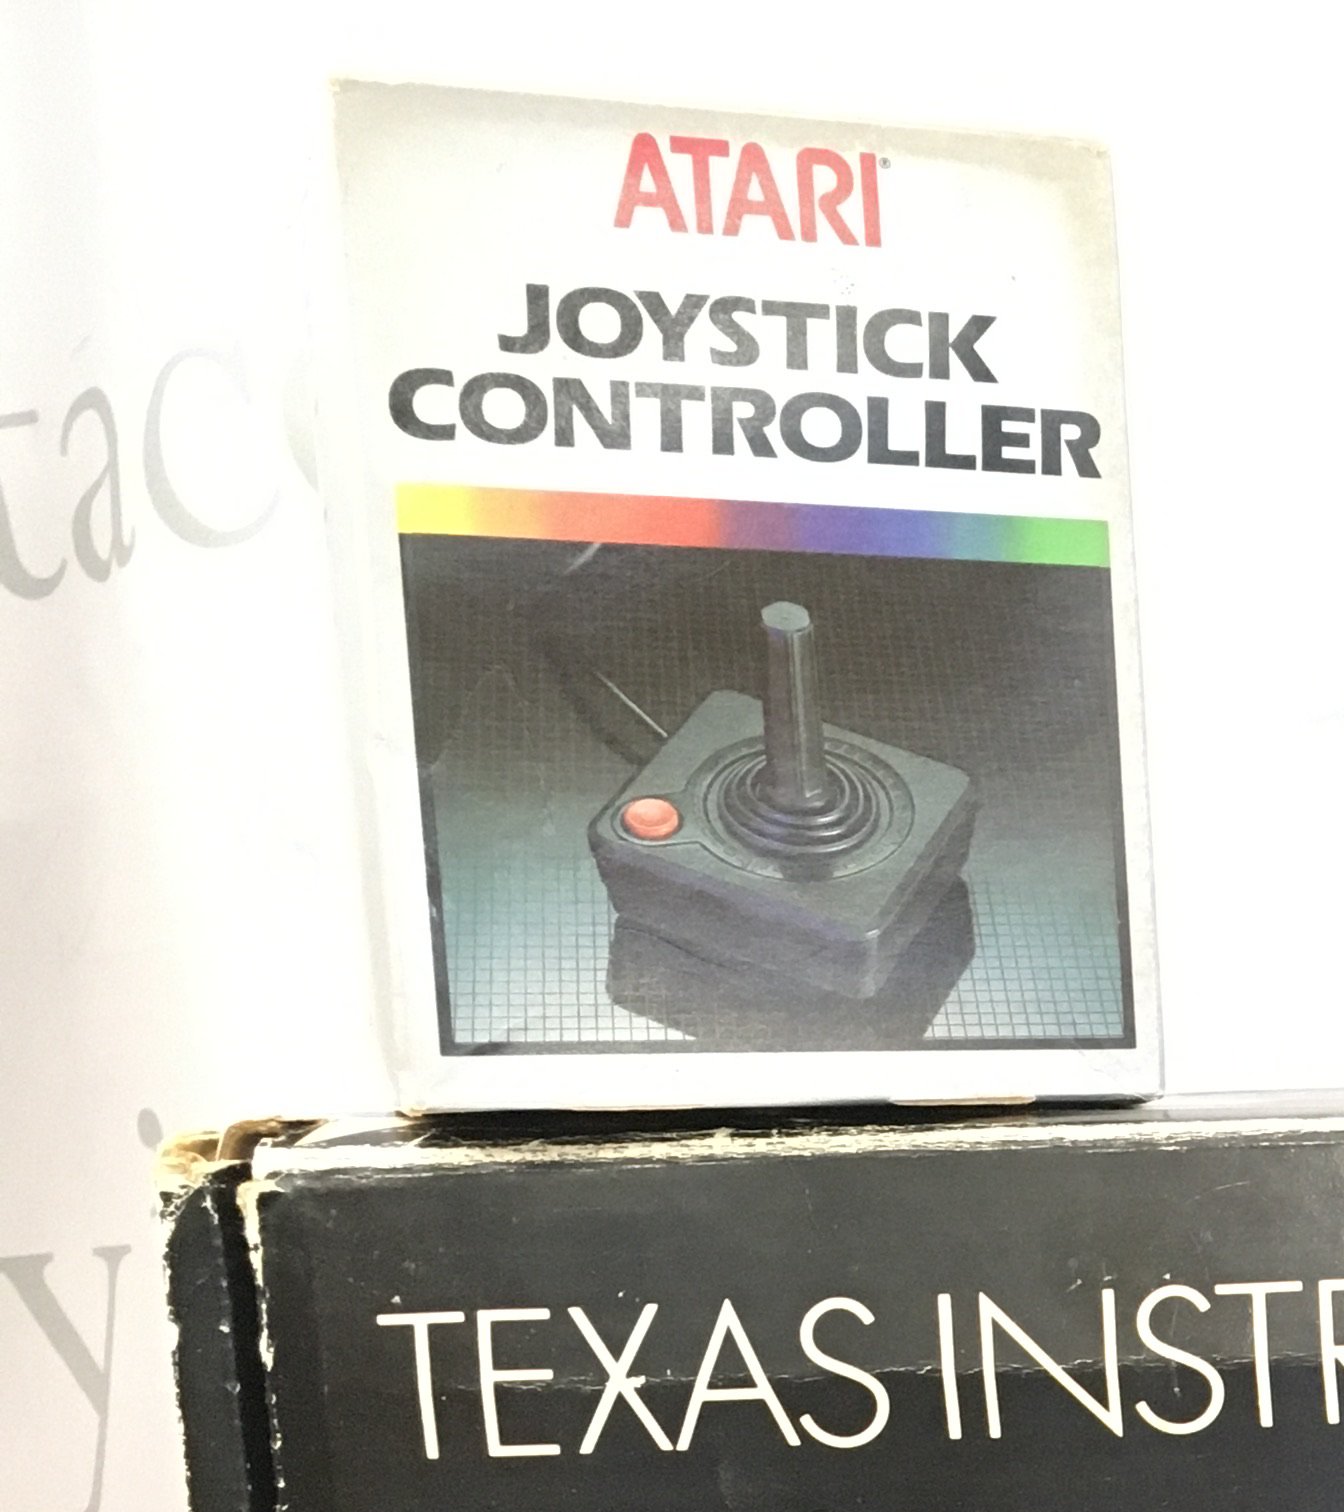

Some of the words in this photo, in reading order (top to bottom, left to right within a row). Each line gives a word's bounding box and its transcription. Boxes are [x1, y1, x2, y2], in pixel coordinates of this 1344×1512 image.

[613, 132, 884, 248] ATARI
[497, 283, 998, 384] JOYSTICK
[388, 367, 1102, 479] CONTROLLER
[376, 1296, 890, 1460] TEXAS
